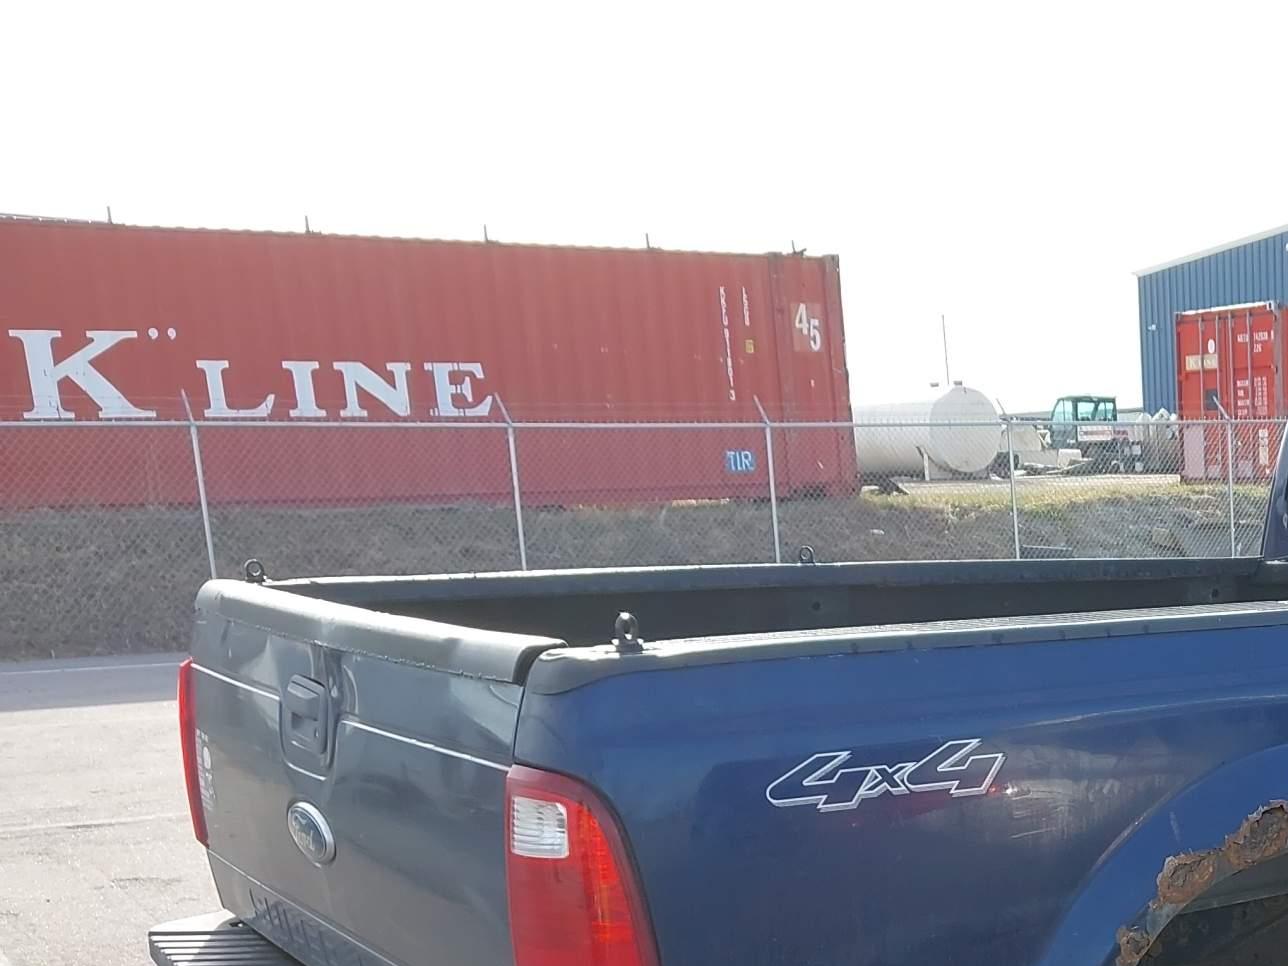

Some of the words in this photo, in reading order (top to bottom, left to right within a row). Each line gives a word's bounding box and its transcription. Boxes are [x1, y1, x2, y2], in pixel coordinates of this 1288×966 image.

[795, 303, 821, 352] 45
[195, 359, 494, 418] LINE
[727, 450, 754, 471] TIR
[766, 738, 1006, 813] 4x4
